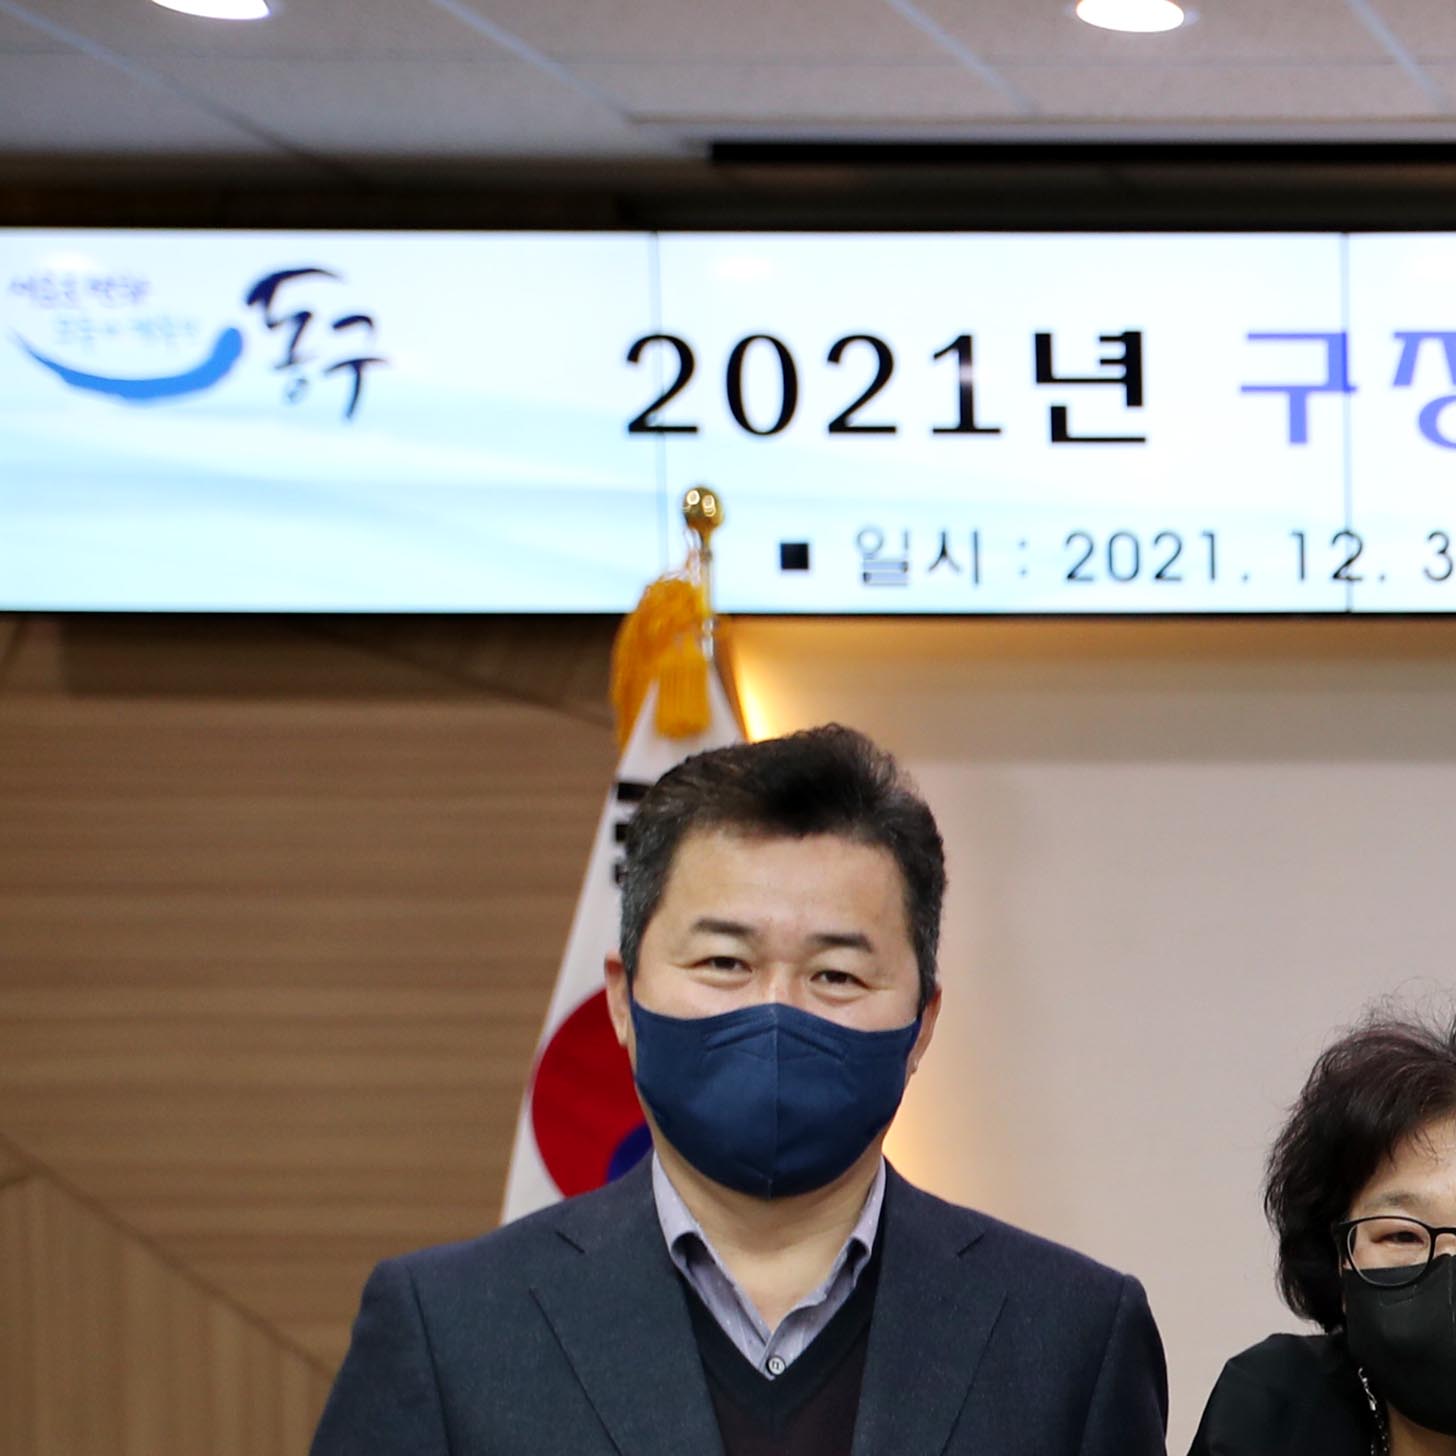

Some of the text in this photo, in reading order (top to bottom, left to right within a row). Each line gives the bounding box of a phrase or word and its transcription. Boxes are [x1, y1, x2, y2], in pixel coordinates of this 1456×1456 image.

[244, 267, 391, 423] 동구
[623, 328, 1147, 445] 2021년
[856, 530, 980, 585] 일시
[1065, 530, 1248, 583] 2021.
[1291, 525, 1385, 586] 12.
